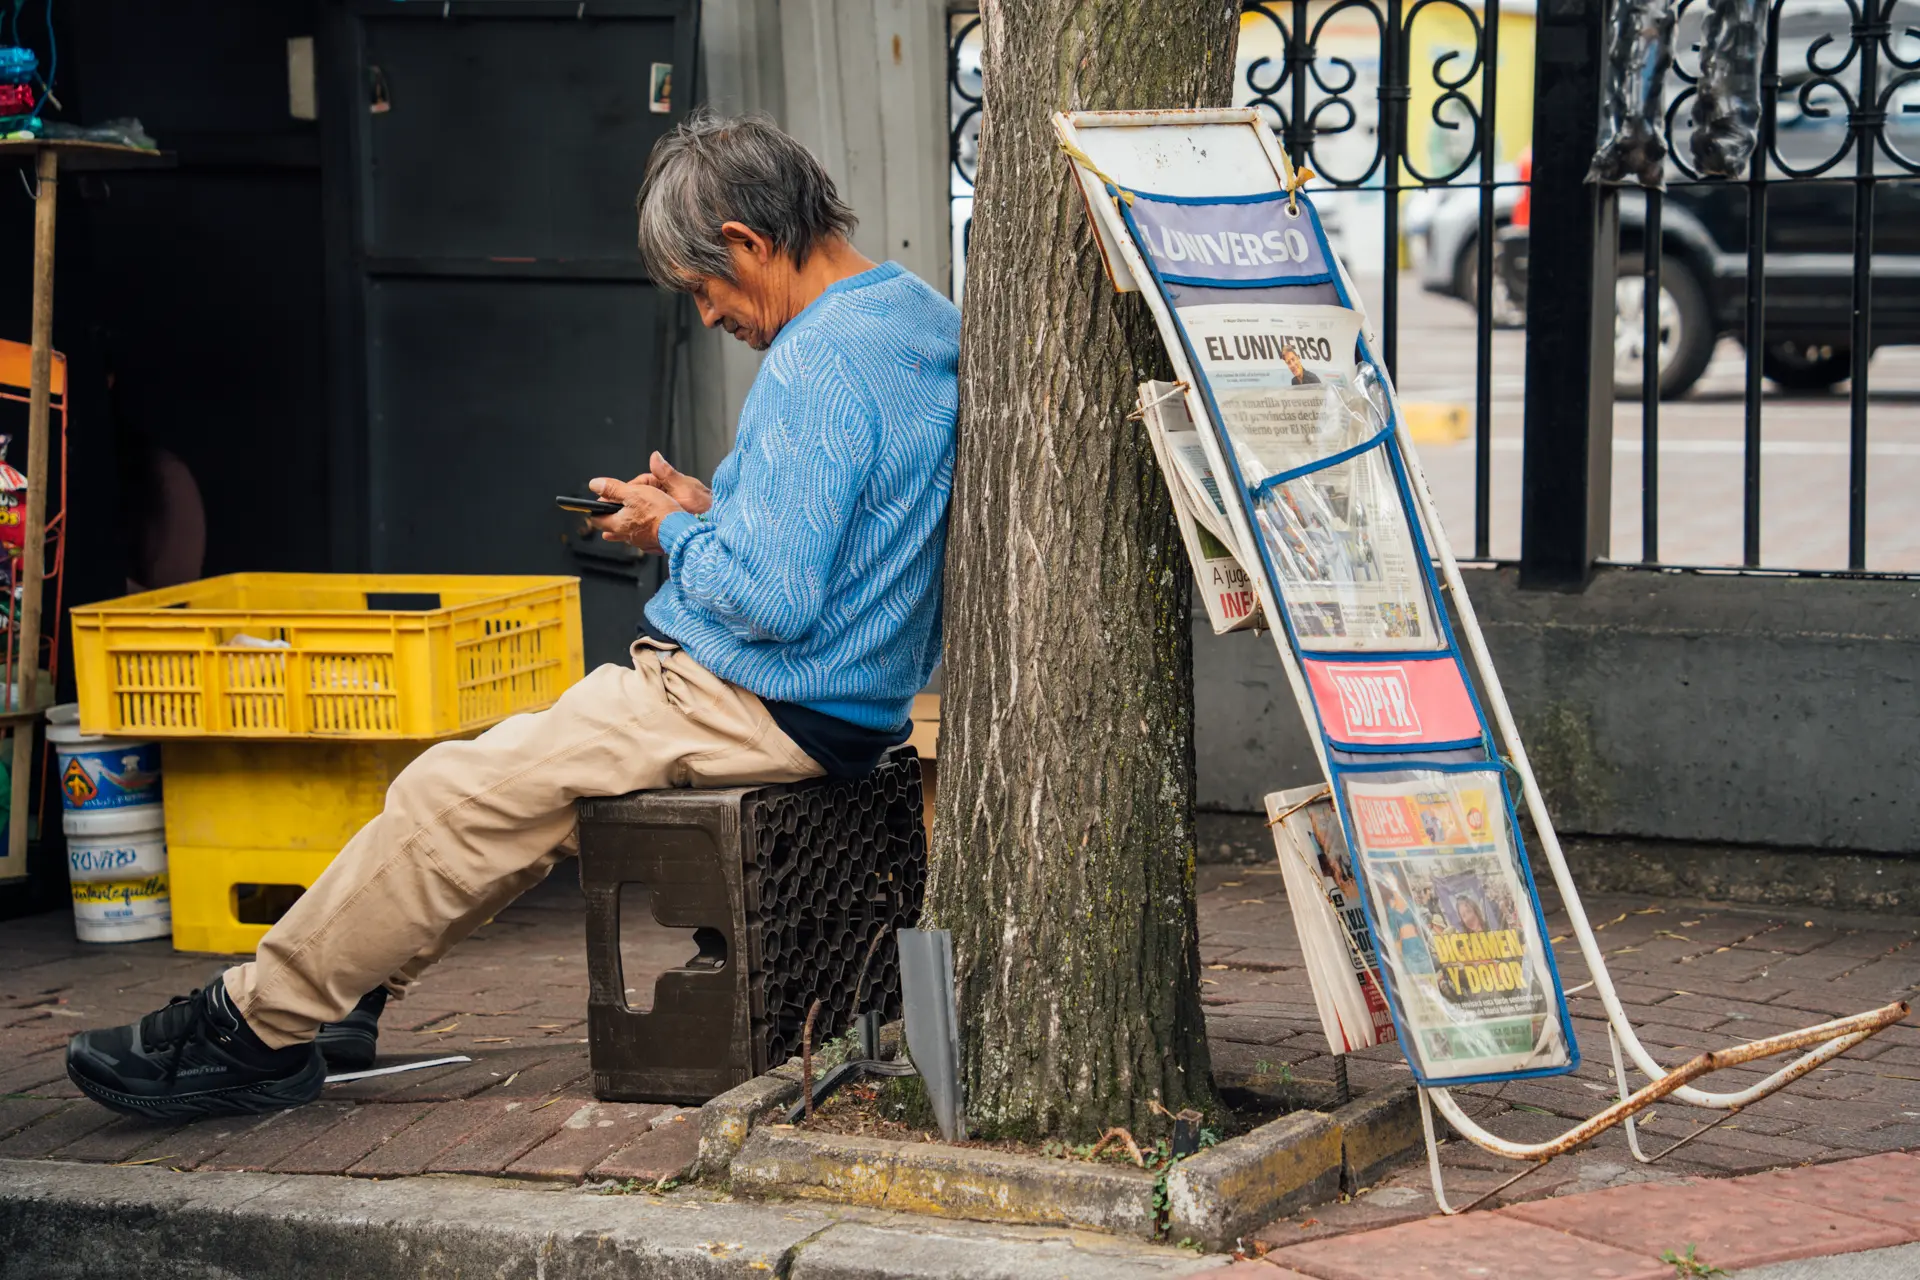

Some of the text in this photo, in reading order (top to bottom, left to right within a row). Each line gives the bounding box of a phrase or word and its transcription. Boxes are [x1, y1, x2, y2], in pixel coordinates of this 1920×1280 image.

[1160, 225, 1309, 266] UNIVERSO
[1205, 335, 1333, 362] EL UNIVERSO
[1243, 396, 1280, 409] amarilla
[1275, 426, 1288, 437] por
[1290, 424, 1300, 434] El
[1213, 566, 1224, 586] A
[1336, 675, 1412, 727] SUPER
[1359, 798, 1411, 835] SUPER
[1434, 928, 1524, 964] DICTAMEN
[1446, 960, 1528, 996] Y DOLOR
